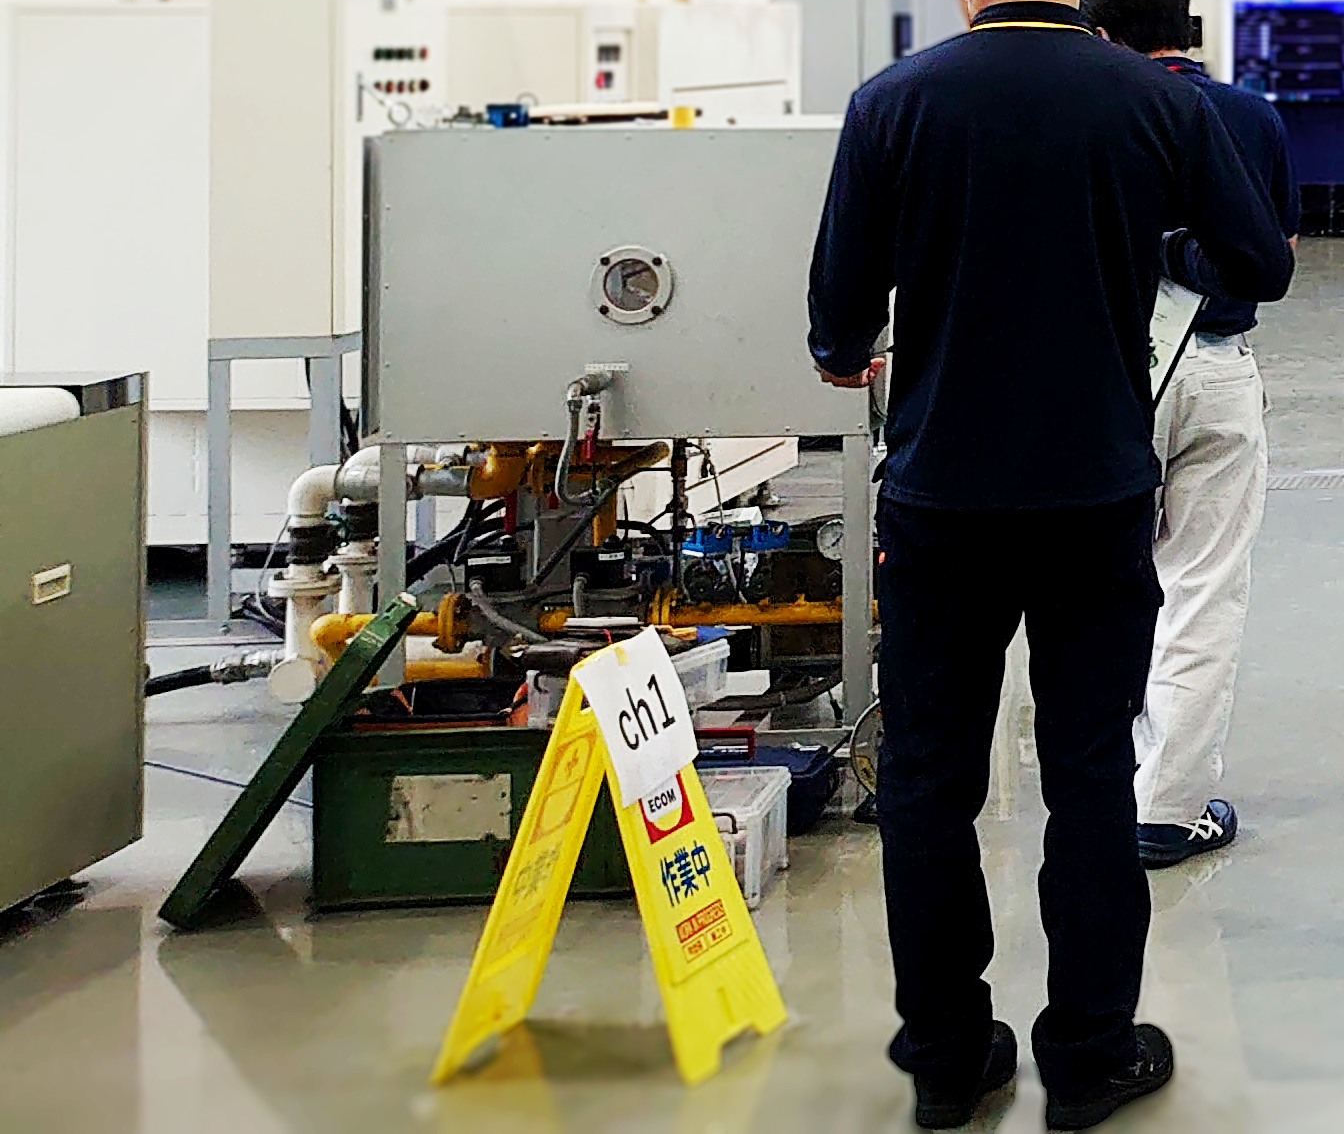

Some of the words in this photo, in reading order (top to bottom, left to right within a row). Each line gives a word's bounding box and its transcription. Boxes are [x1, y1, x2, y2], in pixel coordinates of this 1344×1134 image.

[618, 673, 676, 751] ch1
[648, 788, 677, 813] ECOM
[660, 840, 711, 907] 作業中
